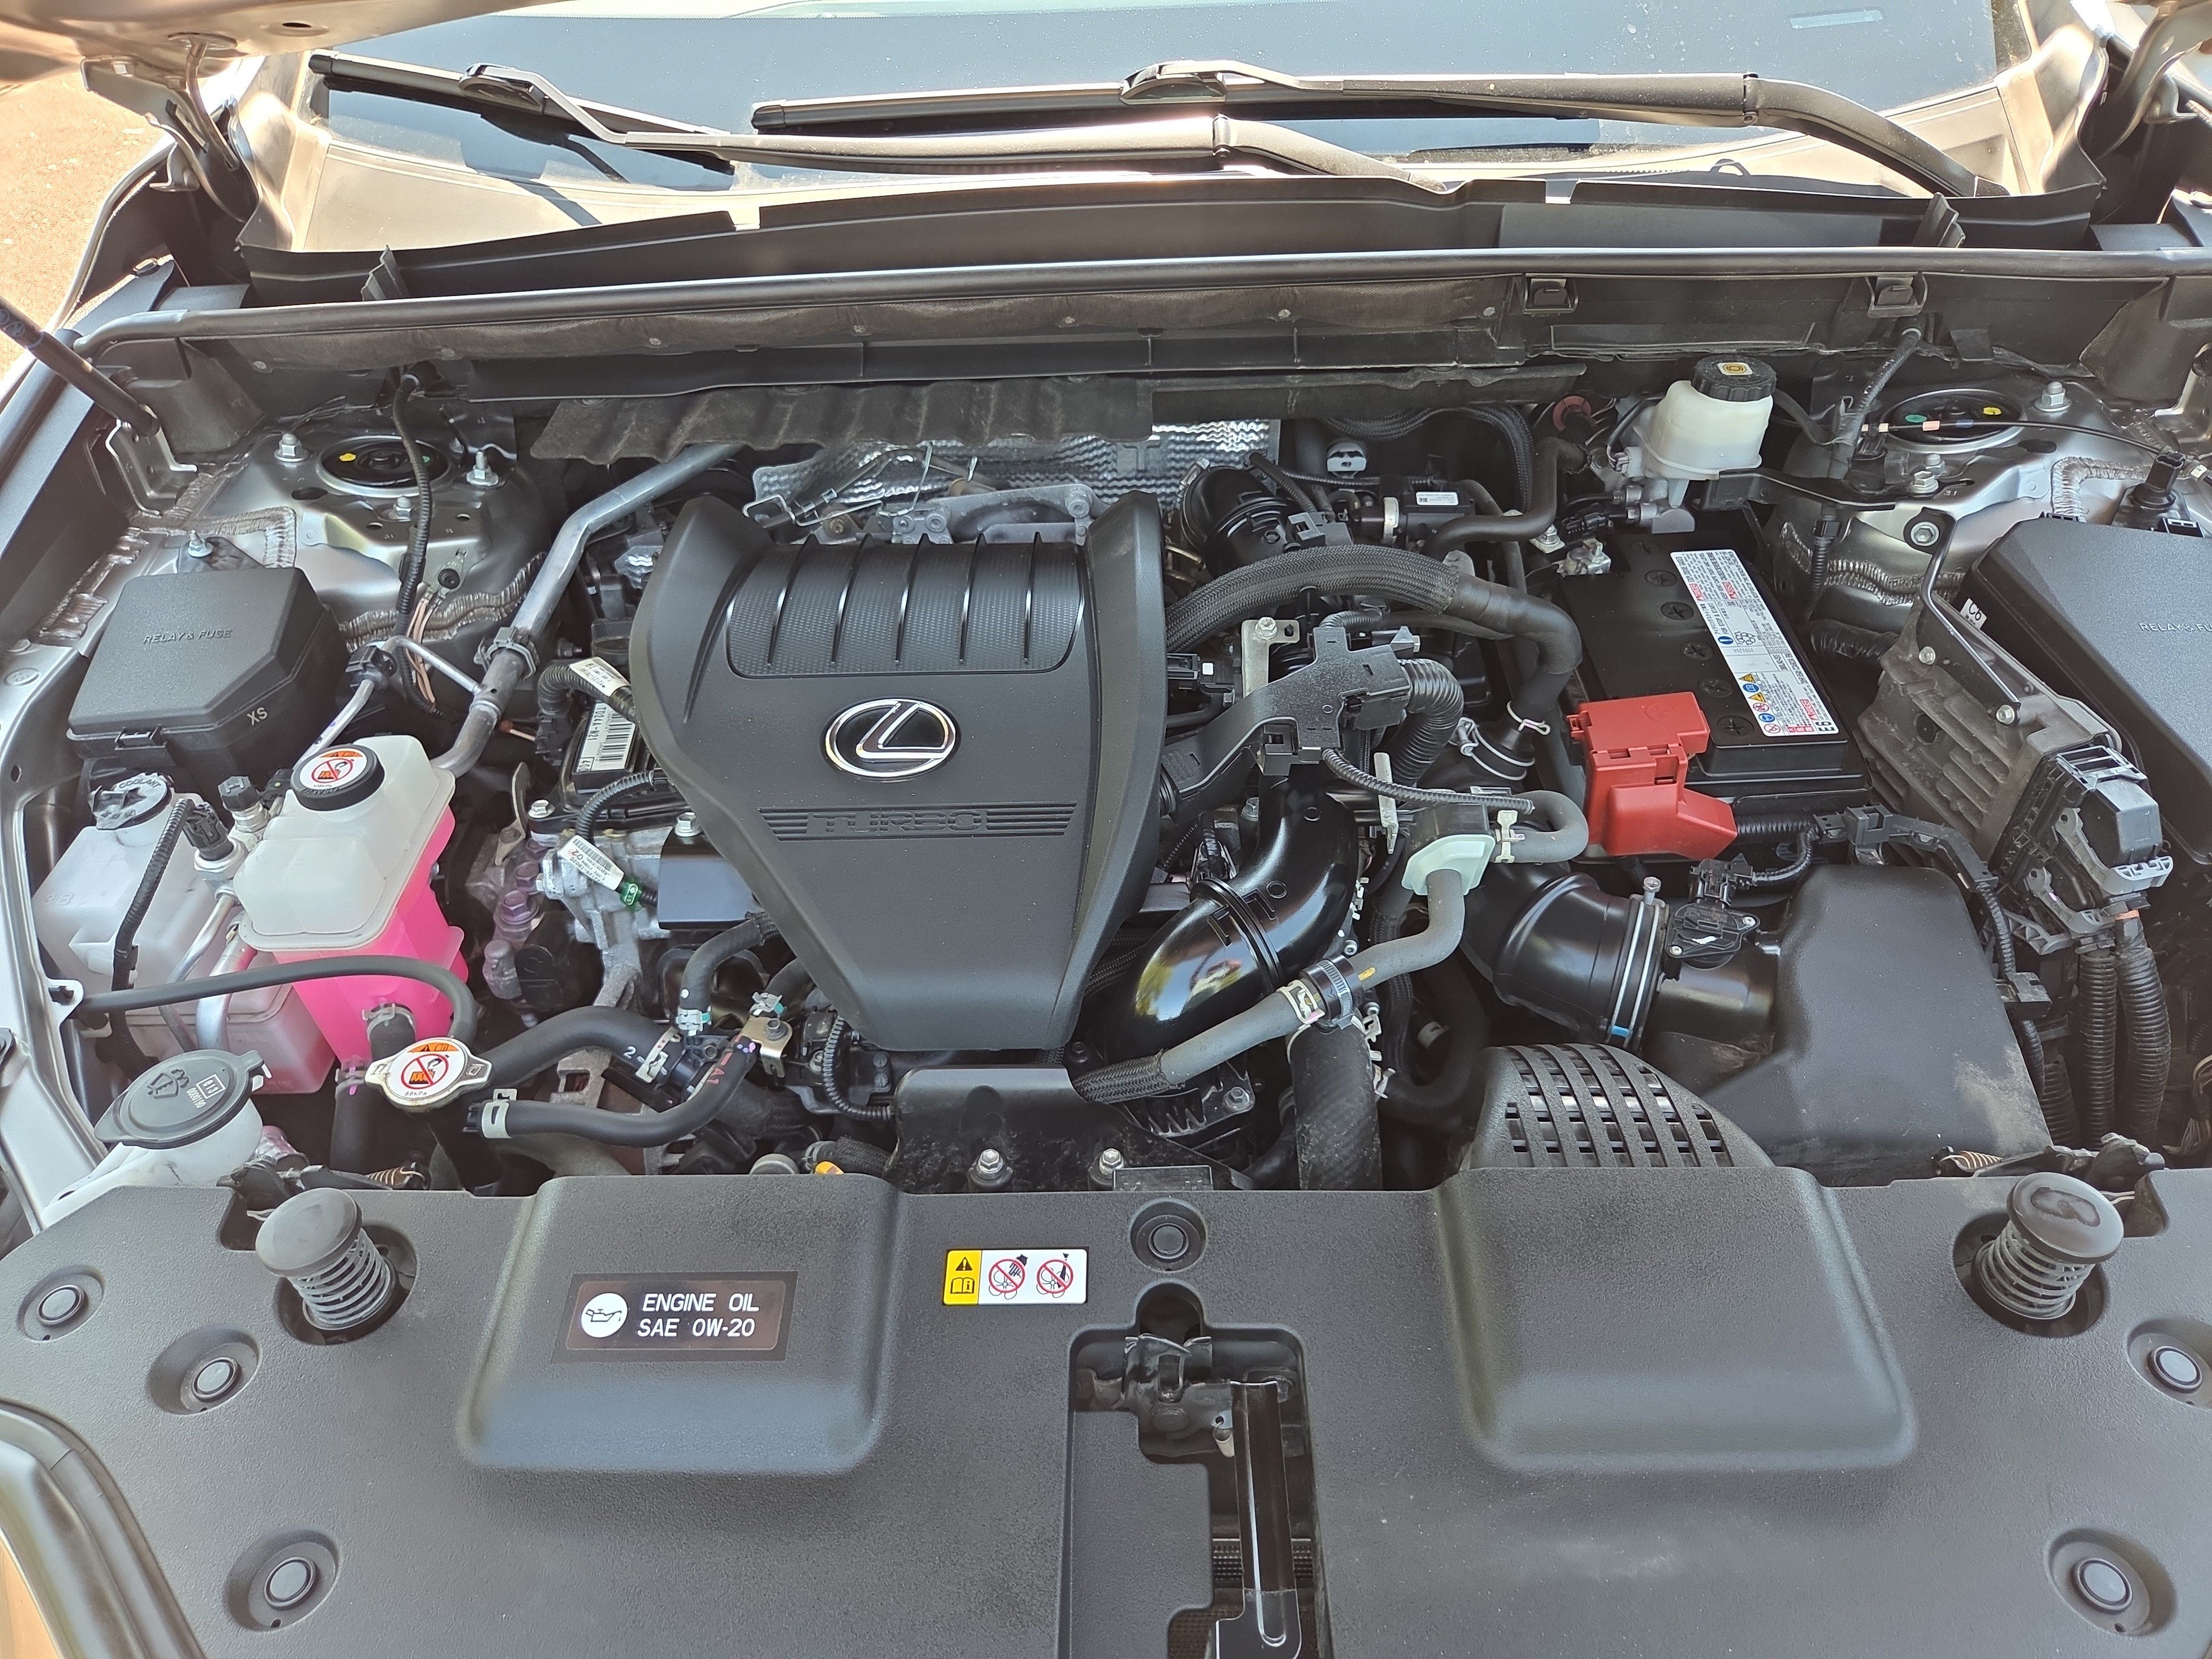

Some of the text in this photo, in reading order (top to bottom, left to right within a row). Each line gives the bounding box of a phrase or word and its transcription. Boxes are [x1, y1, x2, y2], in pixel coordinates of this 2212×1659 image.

[2139, 622, 2182, 632] RELAY
[2184, 623, 2195, 632] &
[143, 629, 233, 644] RELAY & FUSE
[246, 706, 268, 726] XS
[1815, 721, 1836, 732] E6
[118, 777, 162, 788] COOLANT
[814, 811, 982, 833] TURBO
[572, 849, 584, 860] 02
[623, 1046, 637, 1059] 2
[203, 1079, 218, 1094] e13
[642, 1293, 760, 1312] ENGINE OIL
[637, 1317, 755, 1337] SAE 0W-20
